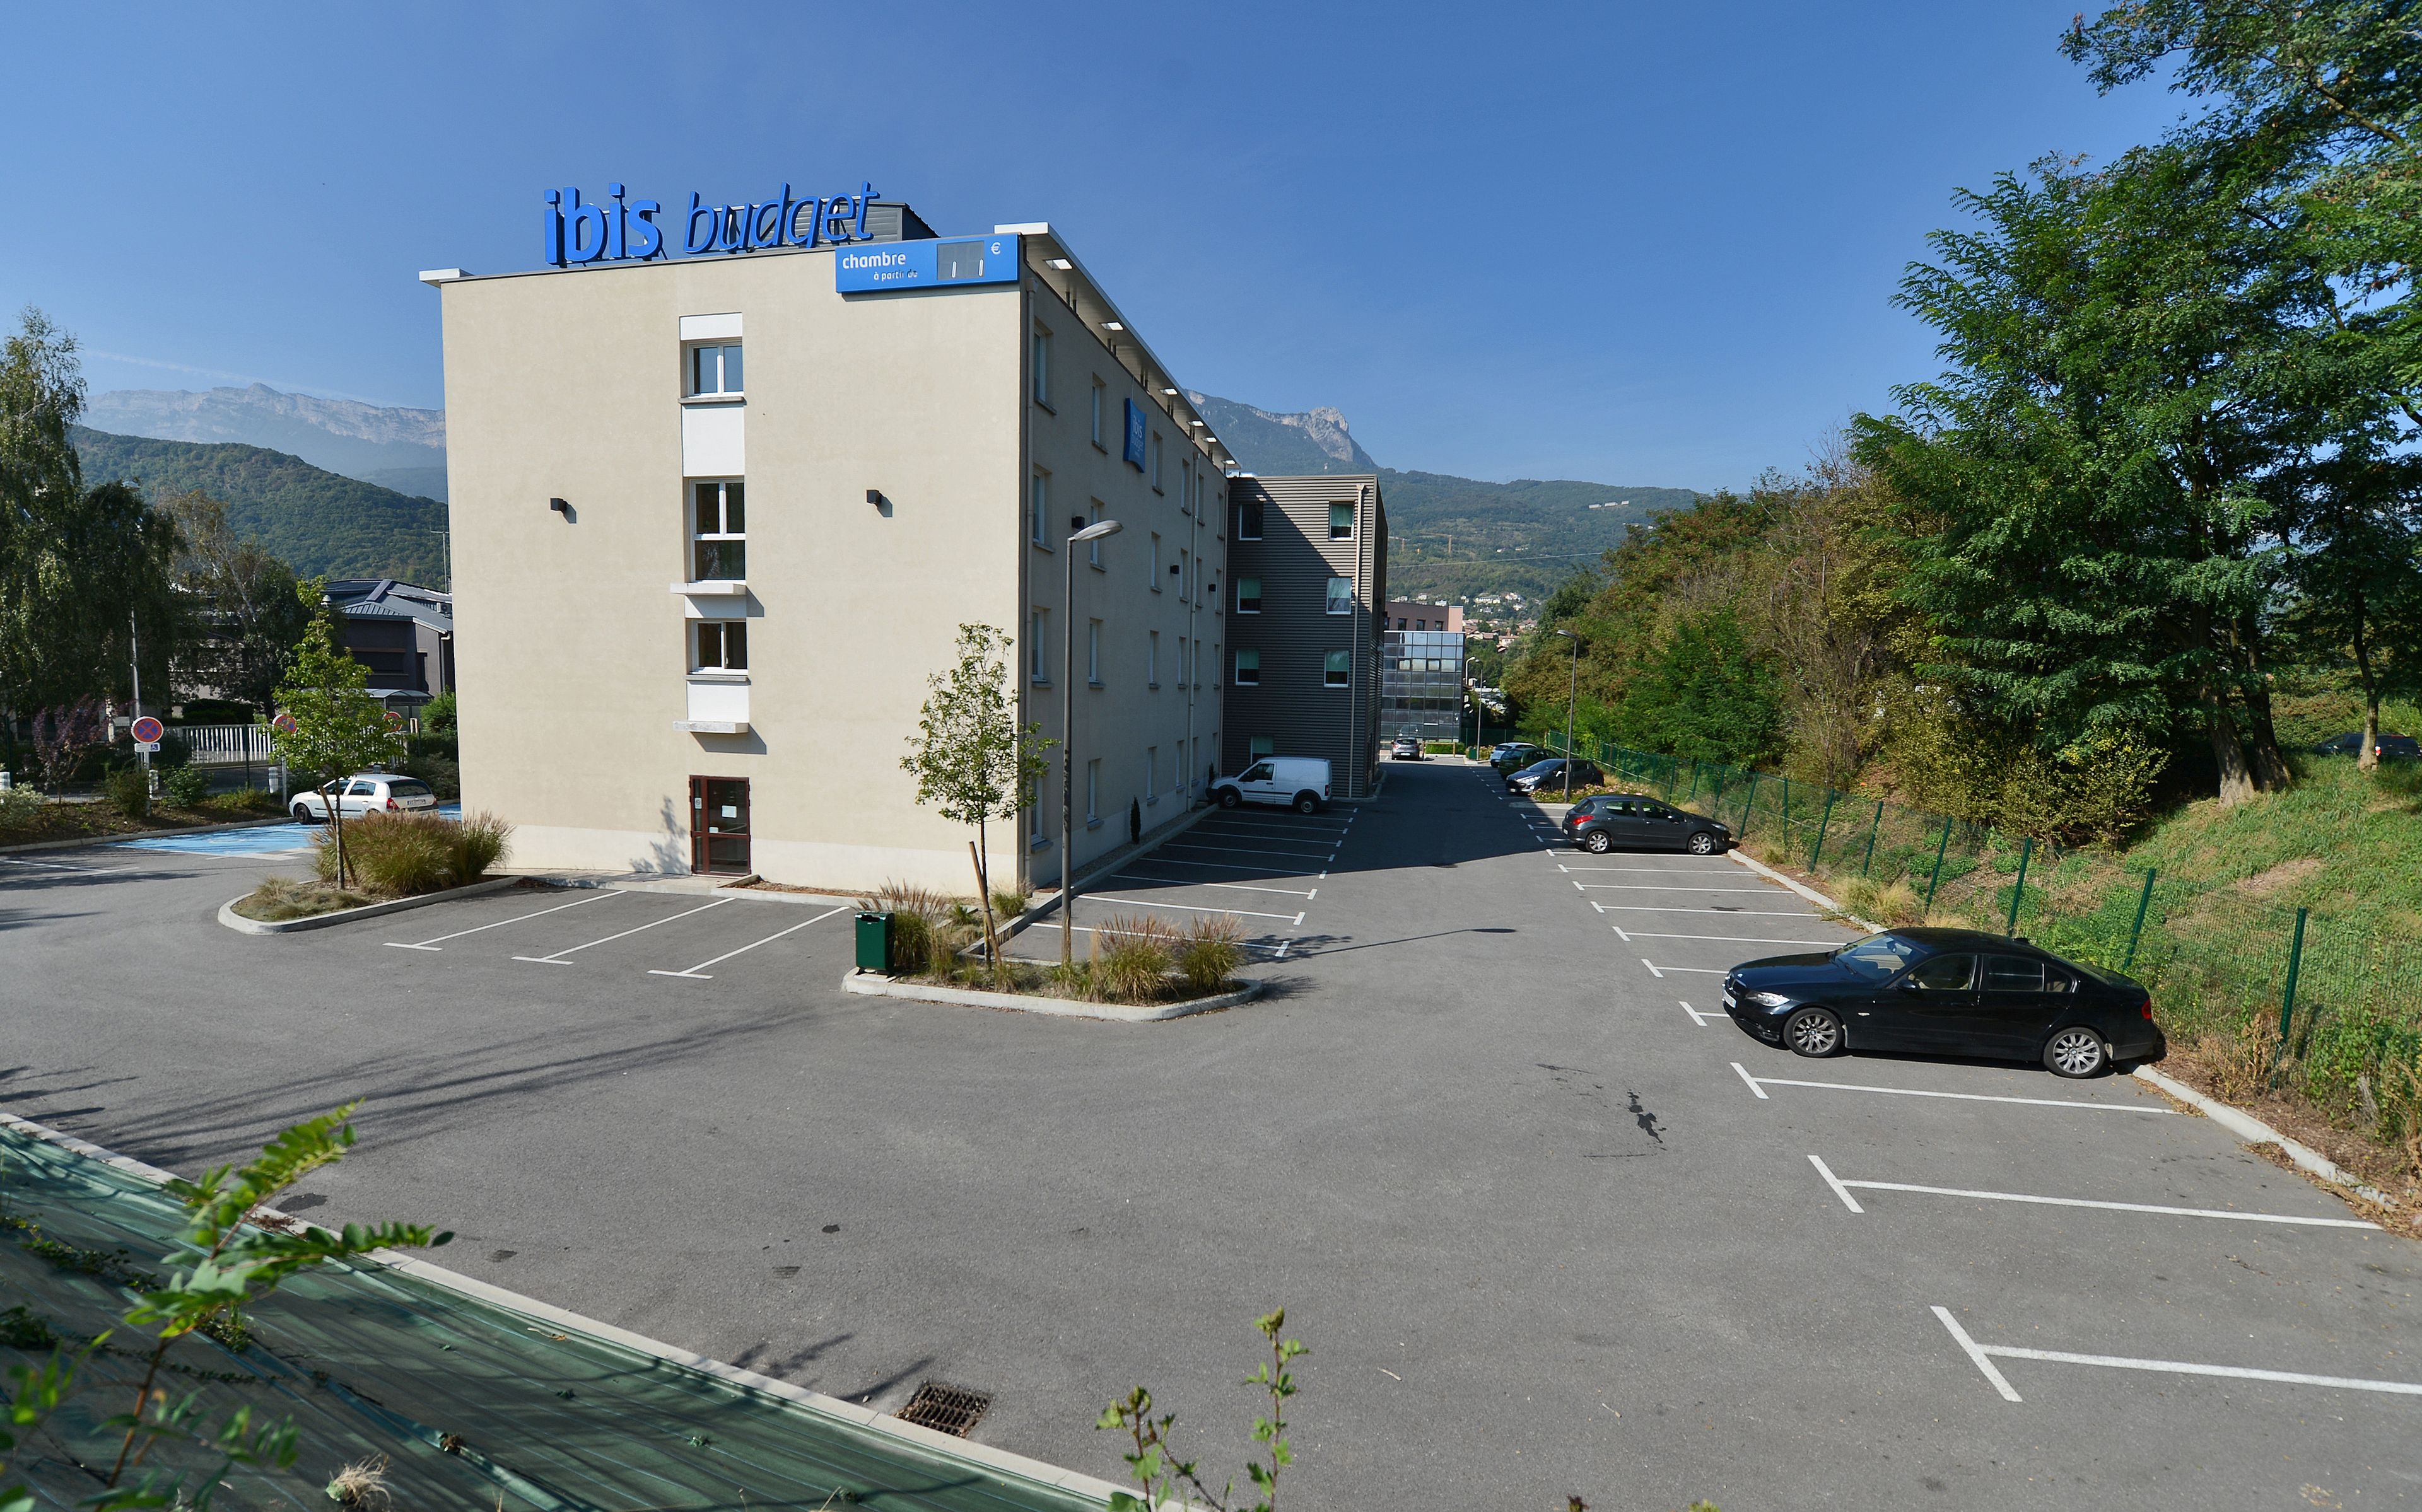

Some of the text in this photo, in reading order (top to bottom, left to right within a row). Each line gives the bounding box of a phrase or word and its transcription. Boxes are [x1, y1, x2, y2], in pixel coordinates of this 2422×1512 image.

[544, 181, 880, 265] ibis budget
[842, 252, 906, 269] chambre
[874, 271, 879, 281] à
[881, 270, 904, 282] partir
[1133, 414, 1142, 439] ibis
